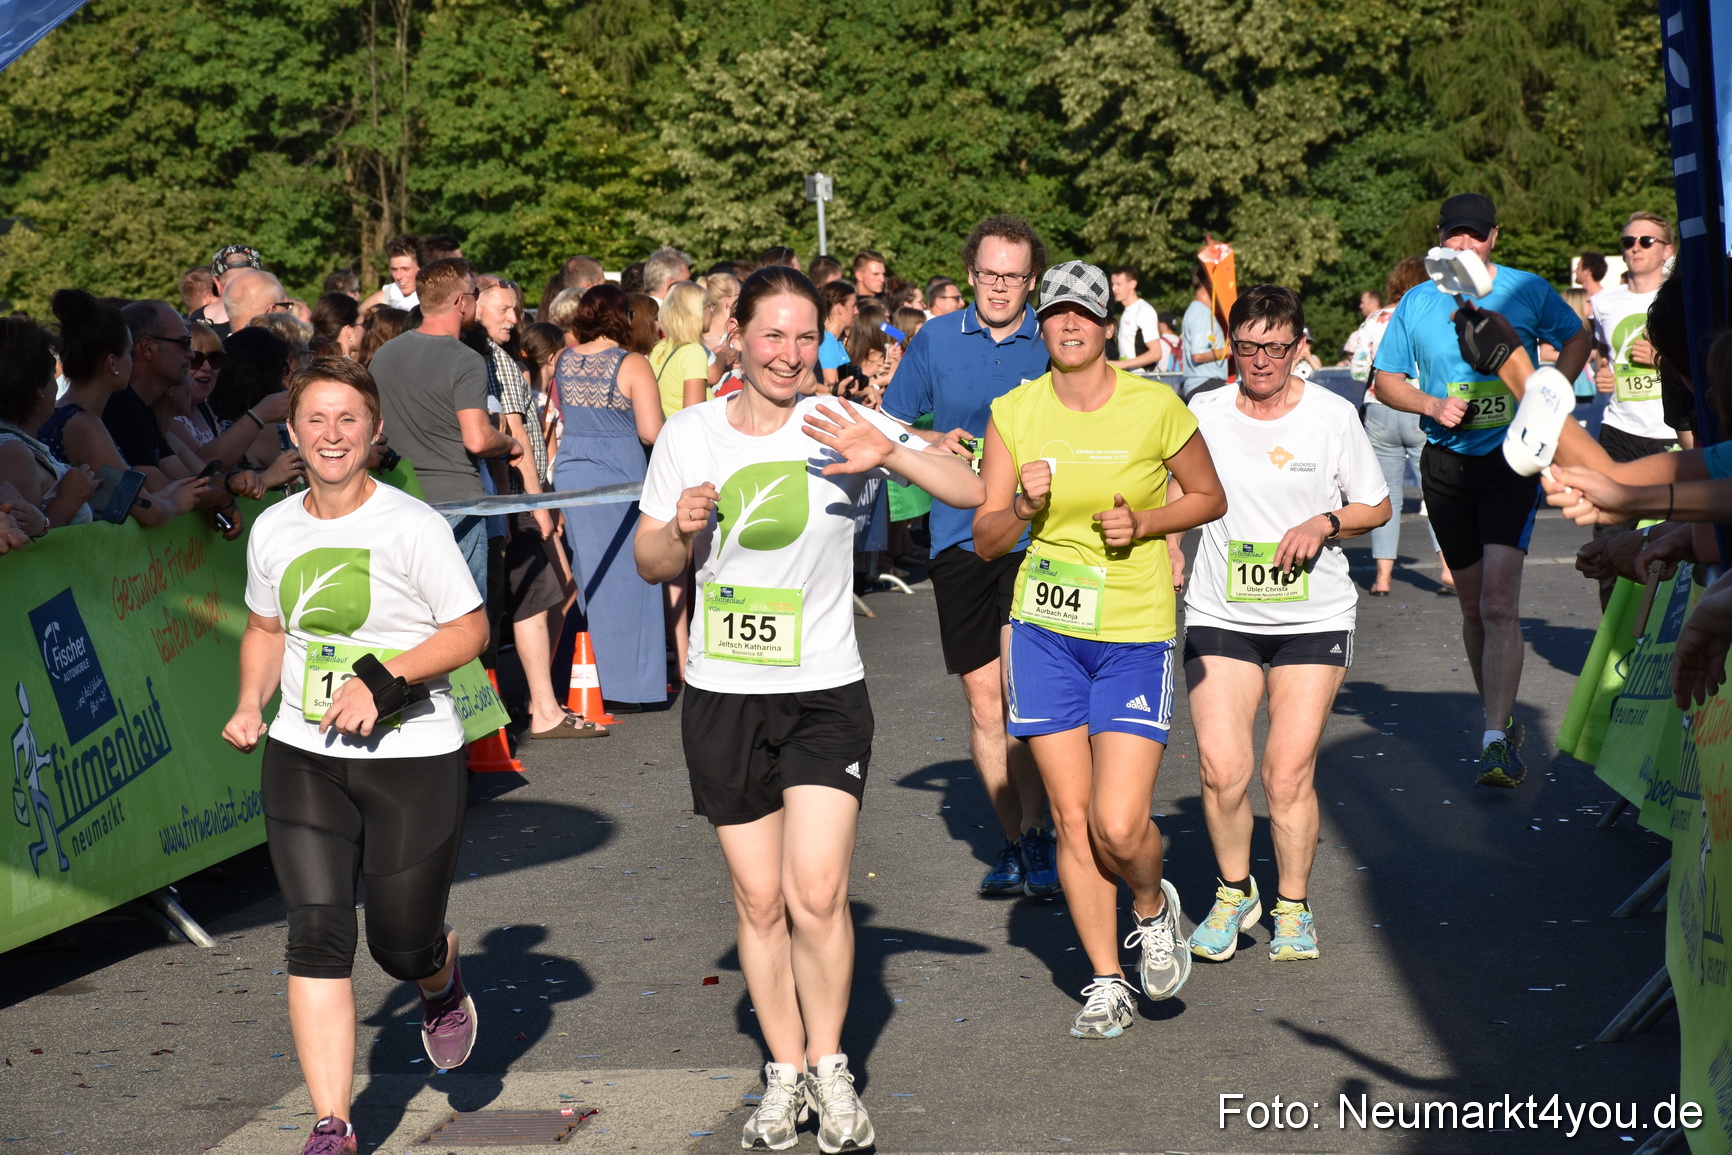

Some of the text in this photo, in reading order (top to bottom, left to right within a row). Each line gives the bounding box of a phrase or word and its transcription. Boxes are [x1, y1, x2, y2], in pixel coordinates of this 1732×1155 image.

[1625, 375, 1653, 391] 183
[1035, 582, 1081, 612] 904
[1036, 606, 1078, 622] Aurbach Anja
[723, 612, 776, 642] 155
[51, 636, 87, 671] Fischer
[718, 640, 782, 652] Jeltsch Katharina
[732, 649, 755, 657] Bionorica
[63, 658, 91, 682] AUTOMOBILE
[313, 699, 335, 708] Schm
[51, 675, 173, 824] firmenlauf
[72, 797, 126, 858] neumarkt
